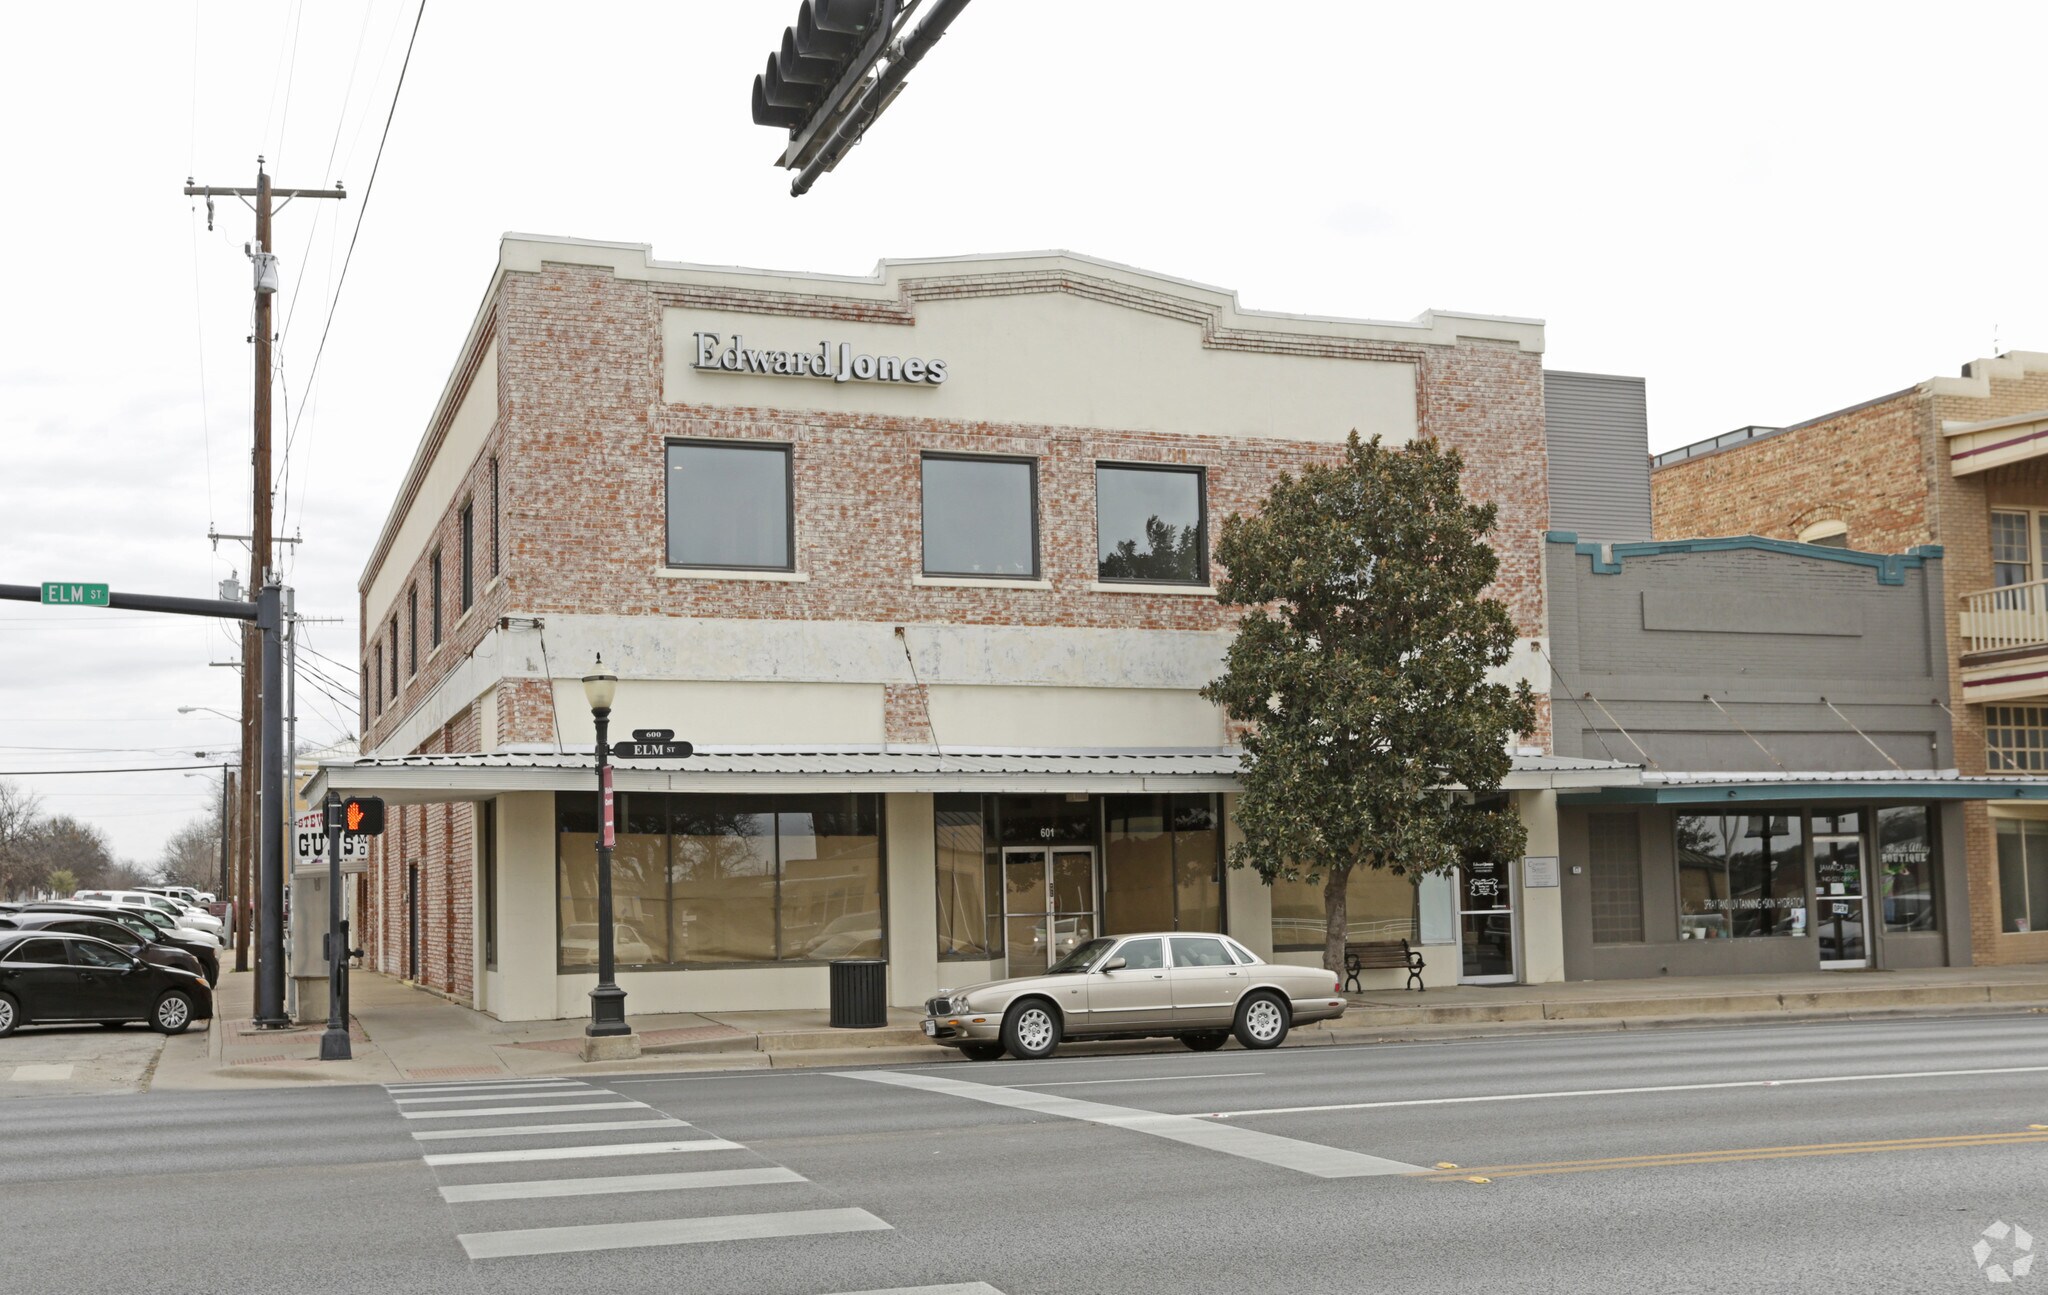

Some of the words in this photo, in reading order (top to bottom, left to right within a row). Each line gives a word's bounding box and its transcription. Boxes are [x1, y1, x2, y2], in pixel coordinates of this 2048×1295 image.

[48, 585, 84, 603] ELM
[90, 589, 102, 600] ST
[633, 744, 664, 755] ELM
[1041, 828, 1054, 838] 601
[298, 833, 354, 856] GUS
[1881, 853, 1927, 863] BOUTIQUE
[1818, 863, 1844, 873] JAMAICA
[1739, 899, 1762, 909] TANNING
[1833, 904, 1848, 913] OPEN
